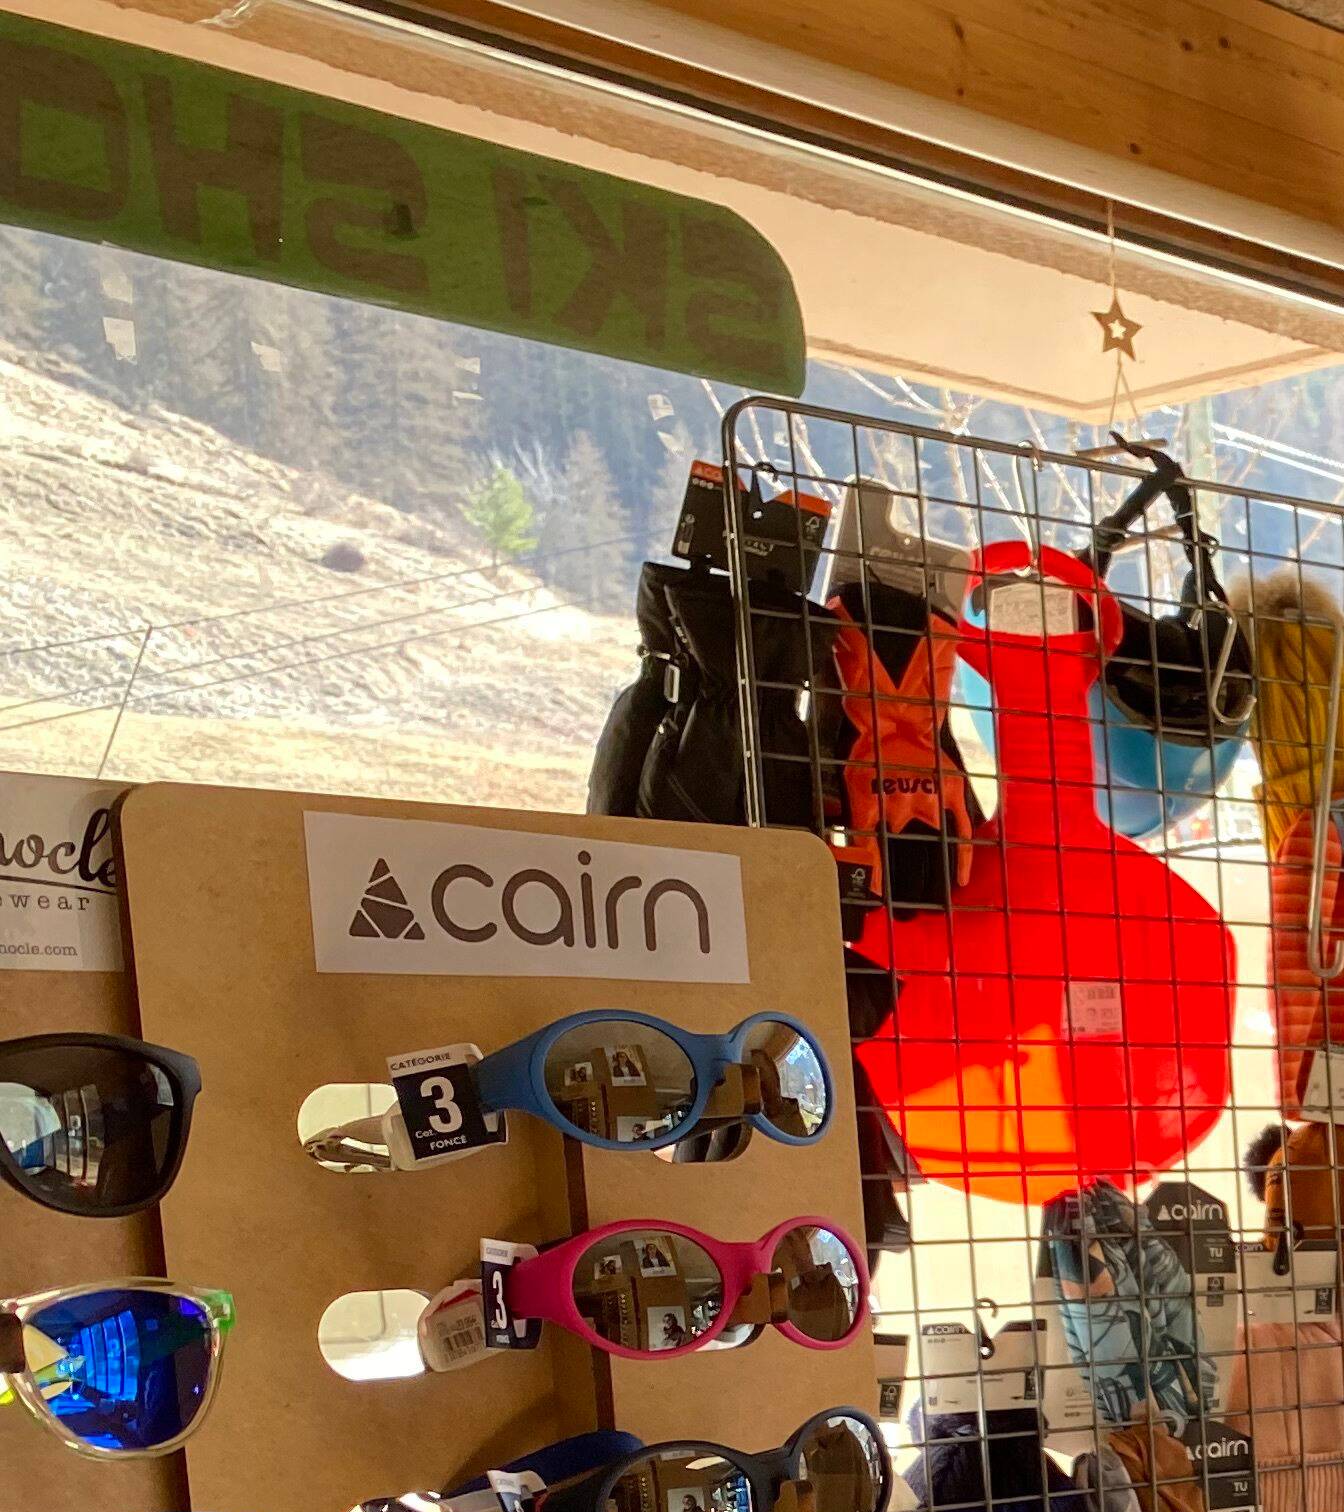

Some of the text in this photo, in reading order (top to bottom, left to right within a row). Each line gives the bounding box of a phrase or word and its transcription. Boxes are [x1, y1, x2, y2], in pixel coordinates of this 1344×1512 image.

[0, 894, 91, 911] wear
[430, 850, 711, 955] cairn
[420, 1076, 463, 1134] 3
[1171, 1200, 1224, 1221] cairn
